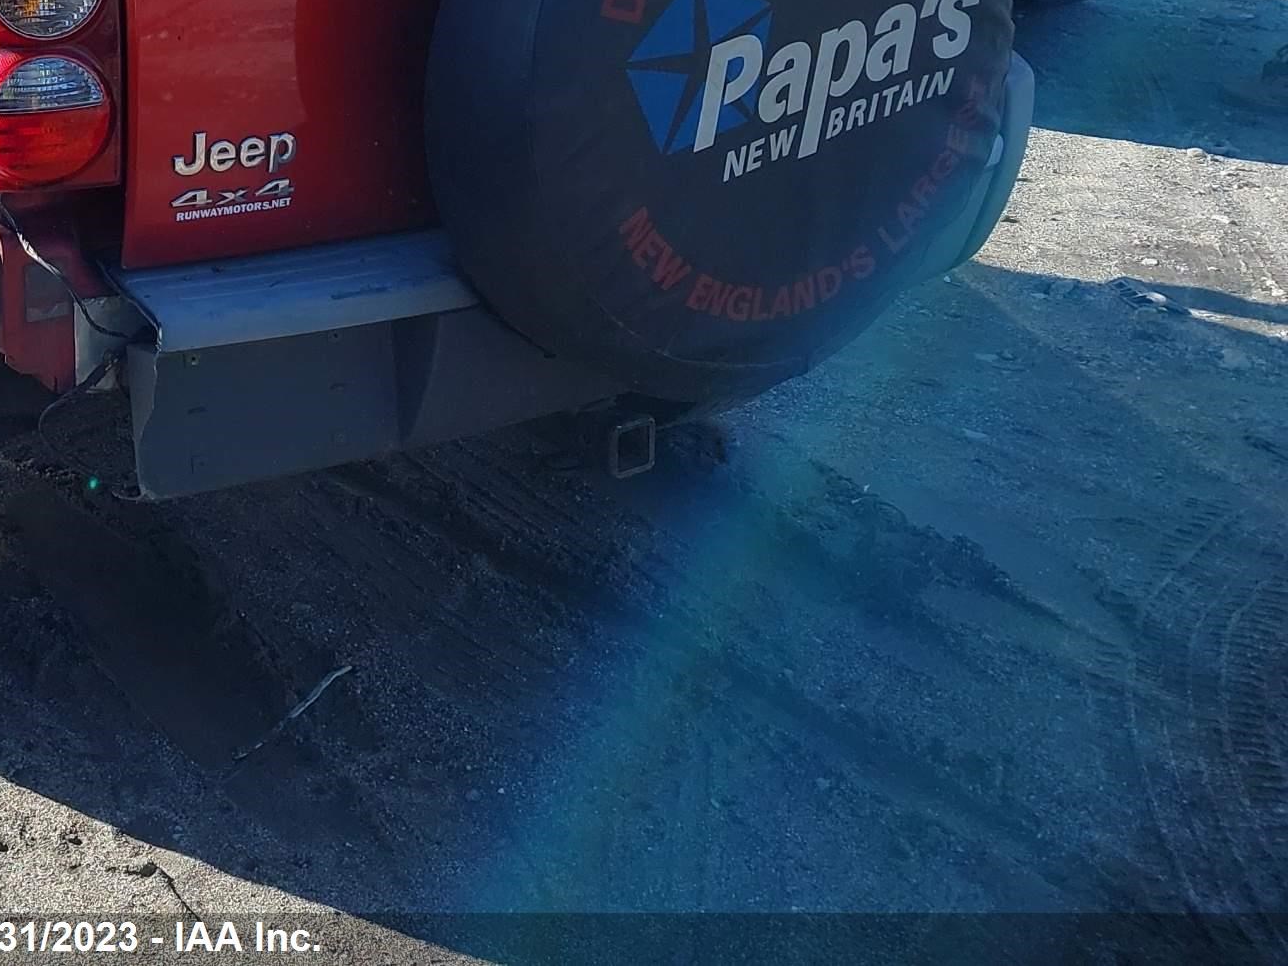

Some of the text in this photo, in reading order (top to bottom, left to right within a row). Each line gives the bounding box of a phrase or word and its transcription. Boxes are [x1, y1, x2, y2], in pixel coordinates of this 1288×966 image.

[172, 131, 296, 176] Jeep
[722, 67, 956, 183] NEW BRITAIN
[175, 197, 292, 222] RUNWAYMOTORS.NET
[619, 205, 692, 291] NEW
[685, 243, 877, 322] ENGLAND'S
